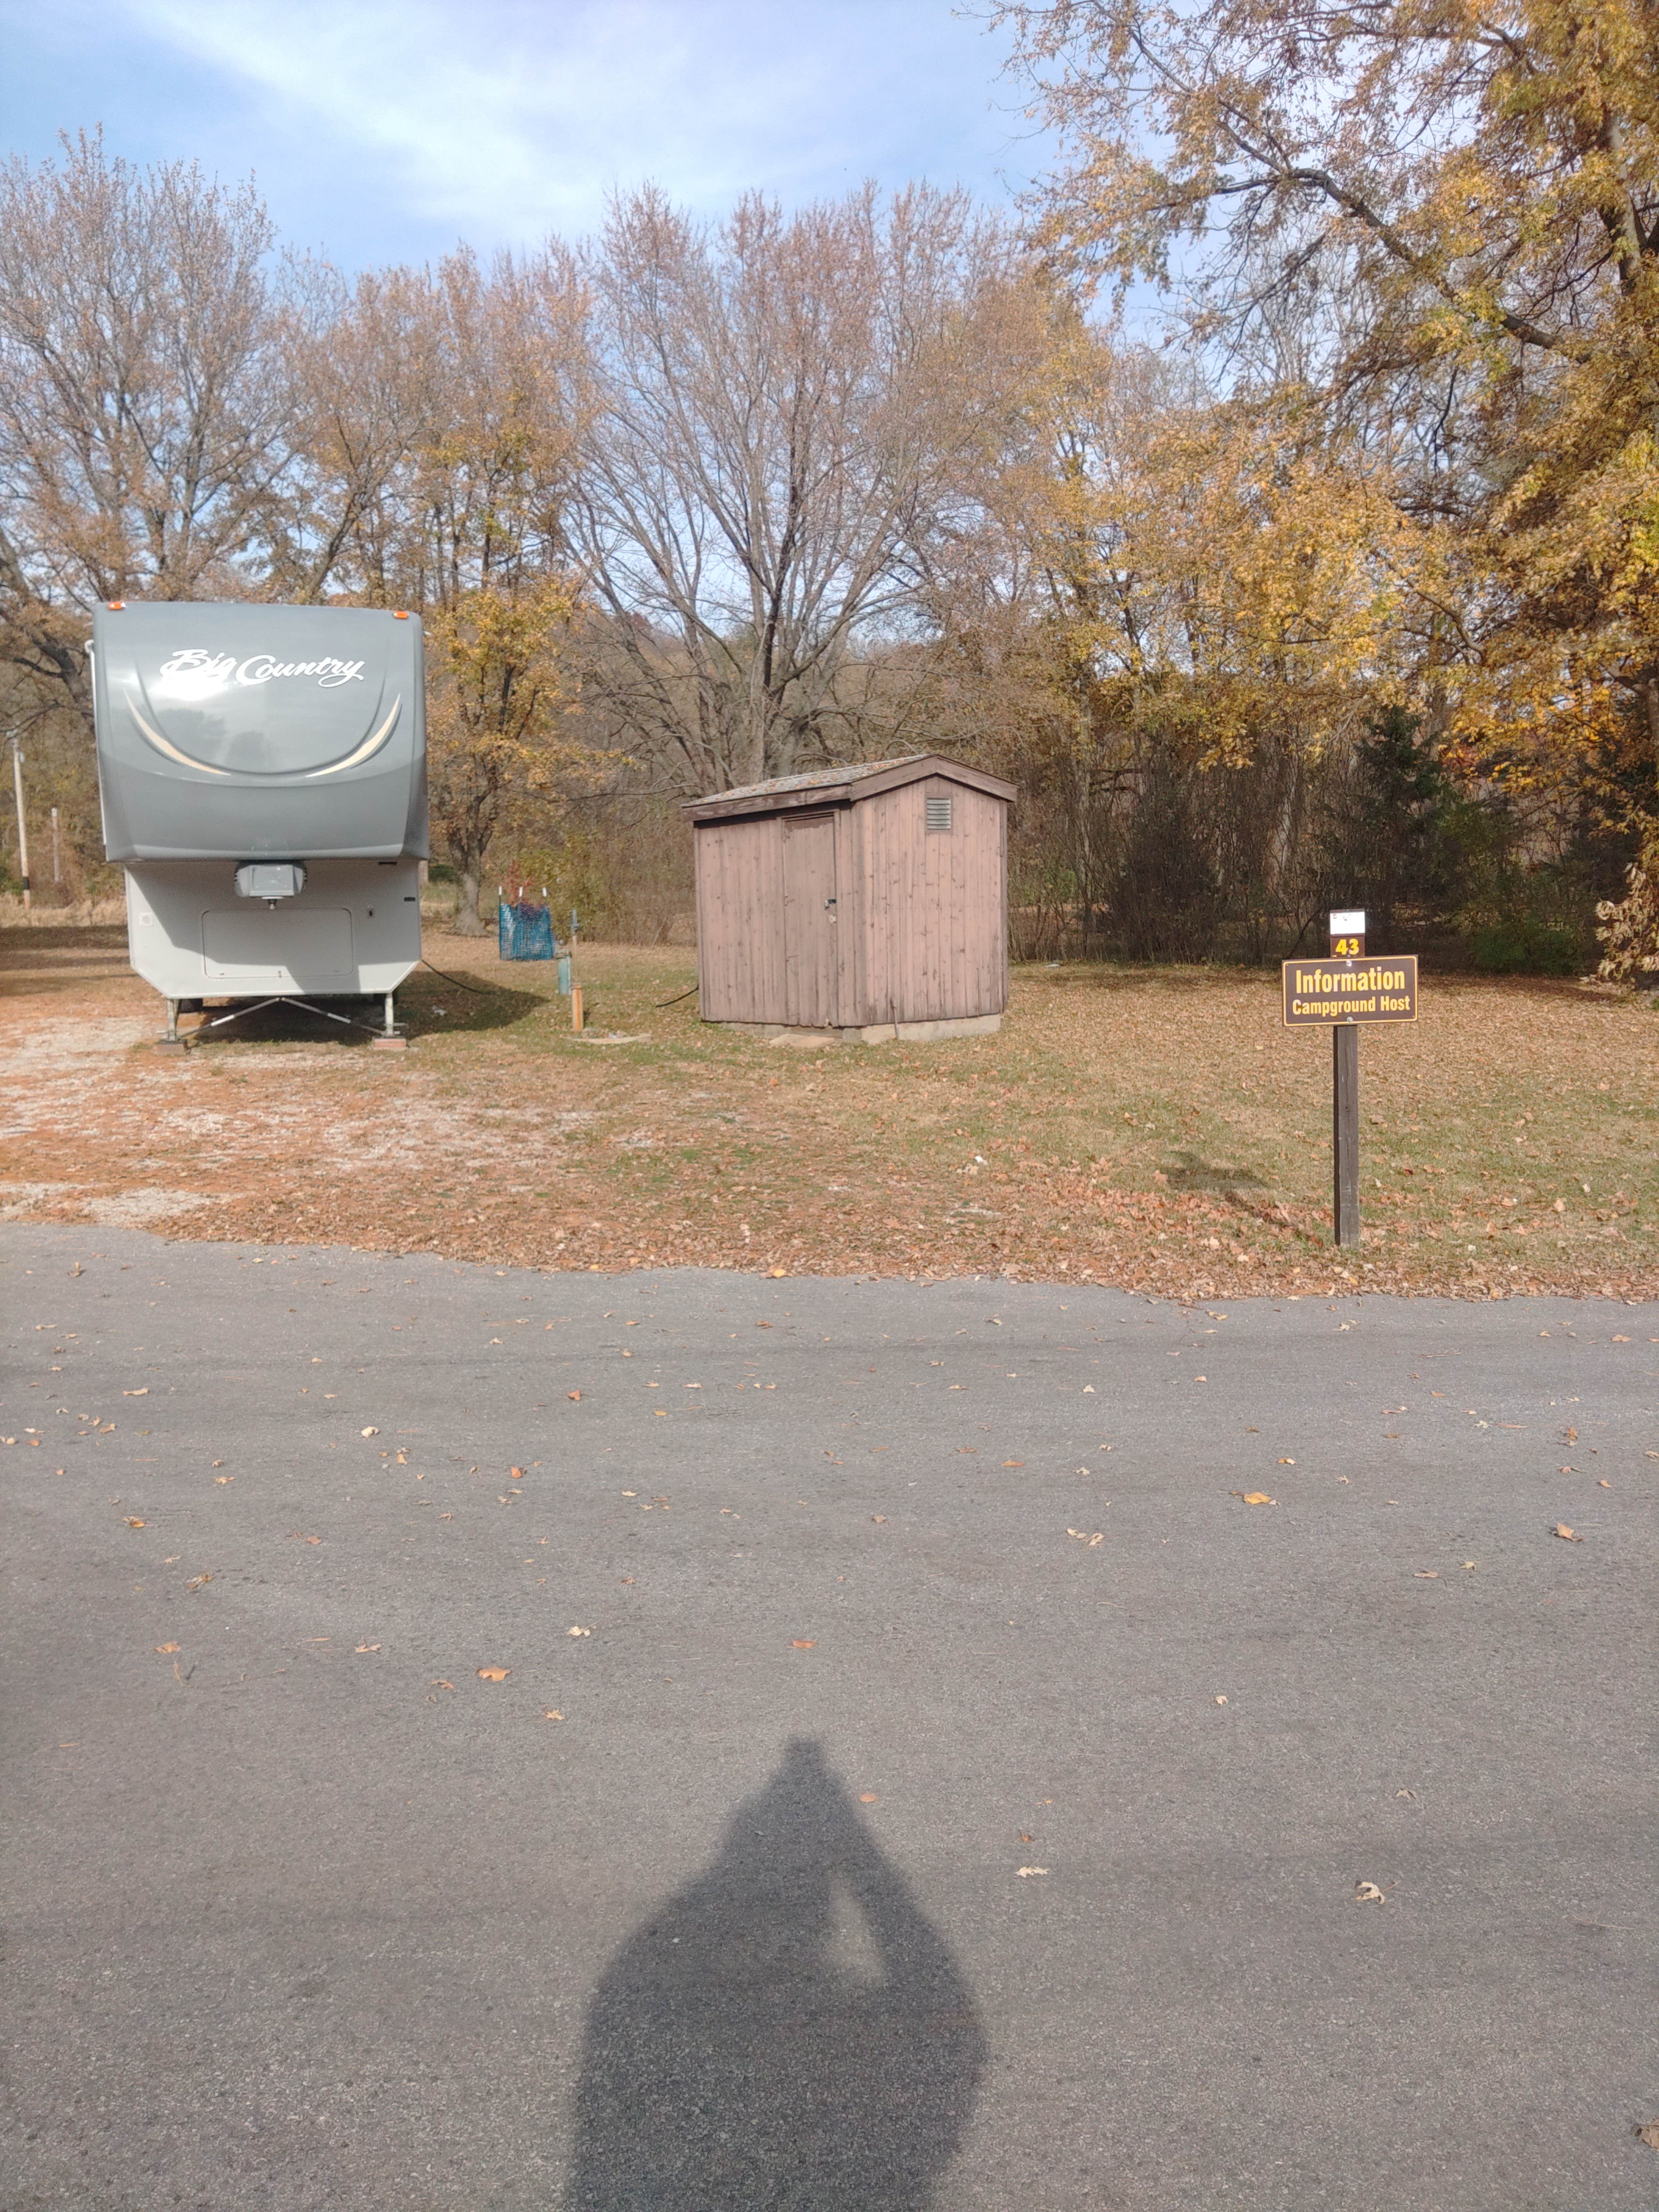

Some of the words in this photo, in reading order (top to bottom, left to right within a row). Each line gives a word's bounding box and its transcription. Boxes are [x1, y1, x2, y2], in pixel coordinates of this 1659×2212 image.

[160, 649, 237, 680] Big
[235, 655, 365, 687] Country
[1336, 938, 1359, 955] 43
[1296, 966, 1405, 994] Information
[1292, 996, 1375, 1017] Campground
[1381, 995, 1410, 1011] Host
